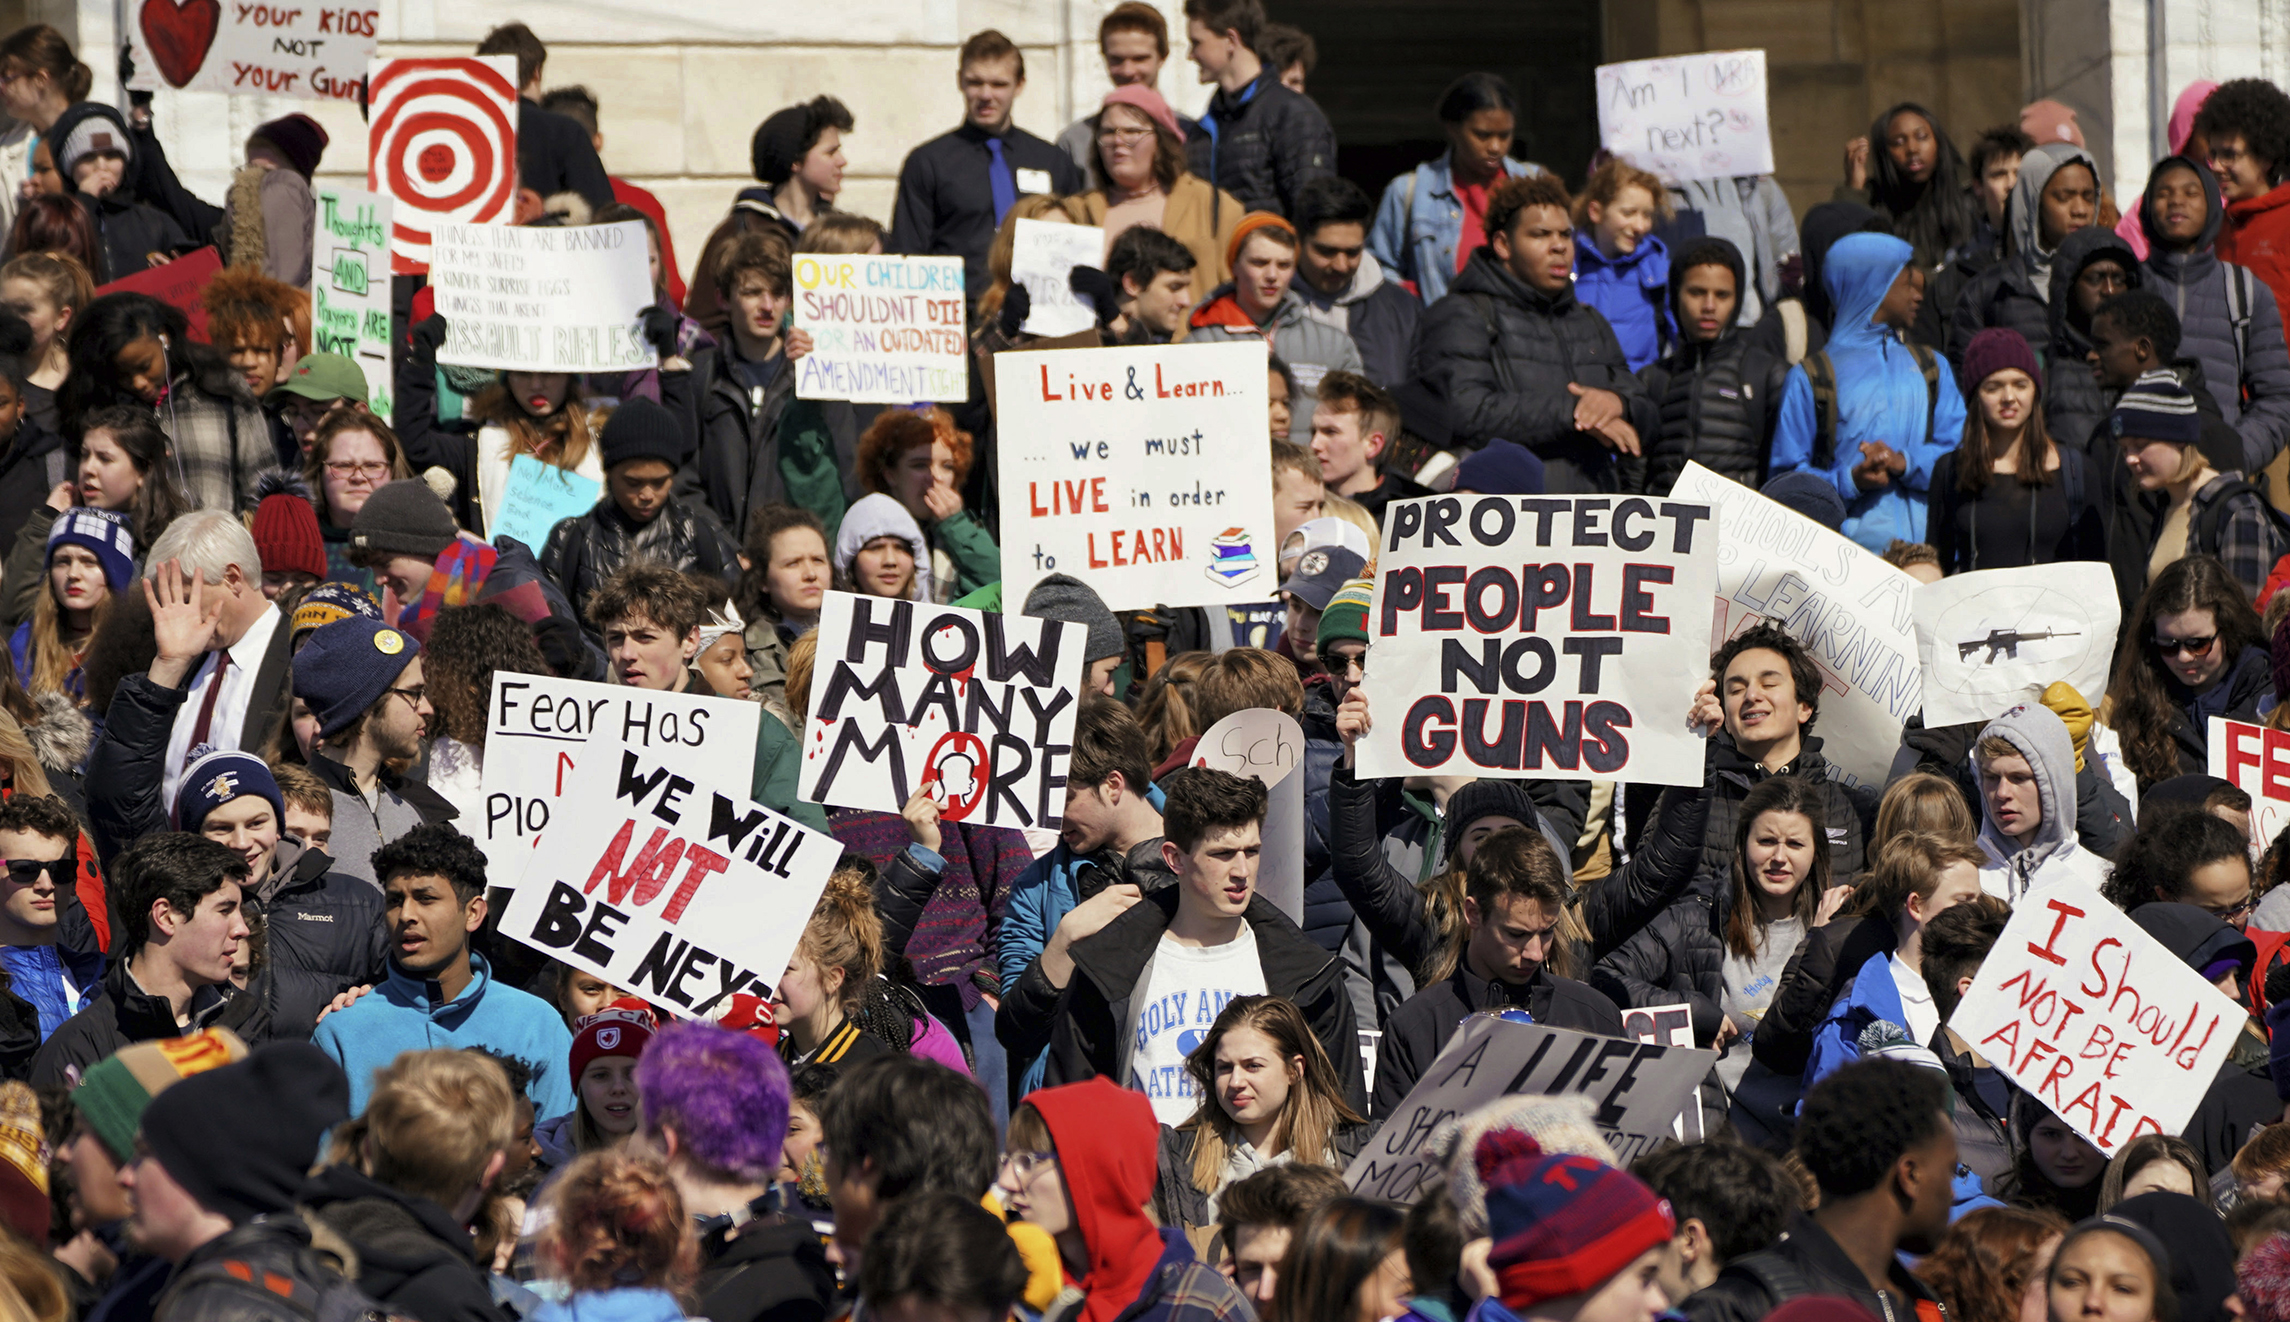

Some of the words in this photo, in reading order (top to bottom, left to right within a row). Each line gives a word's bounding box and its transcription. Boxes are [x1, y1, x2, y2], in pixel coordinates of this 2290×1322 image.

[273, 37, 324, 58] NOT
[1611, 76, 1656, 110] Am
[1681, 67, 1688, 97] I
[1646, 108, 1725, 152] next?
[320, 196, 384, 249] Thoughts
[434, 224, 485, 247] THINGS
[491, 226, 522, 249] THAT
[531, 229, 554, 251] ARE
[564, 226, 624, 251] BANNED
[333, 256, 366, 290] AND
[434, 246, 458, 264] FOR
[486, 251, 524, 271] SAFETY
[794, 259, 857, 290] OUR
[866, 261, 966, 291] CHILDREN
[439, 294, 482, 316] THINGS
[487, 299, 508, 317] THAT
[487, 276, 529, 296] SURPRISE
[538, 277, 571, 296] EGGS
[362, 309, 387, 340] ARE
[802, 291, 919, 325] SHOULDNT
[926, 299, 962, 325] DIE
[442, 317, 542, 362] ASSAULT
[854, 329, 876, 353] AN
[880, 328, 964, 356] OUTDATED
[799, 356, 926, 396] AMENDMENT
[1040, 363, 1114, 402] Live
[1124, 365, 1145, 401] &
[1069, 441, 1110, 460] we
[1144, 428, 1204, 456] must
[516, 466, 533, 481] No
[1029, 476, 1110, 518] LIVE
[1131, 489, 1151, 508] in
[1169, 480, 1226, 507] order
[1388, 496, 1711, 555] PROTECT
[1031, 543, 1056, 571] to
[1380, 562, 1675, 637] PEOPLE
[846, 597, 1064, 689] HOW
[1440, 636, 1623, 695] NOT
[499, 682, 610, 735] Fear
[815, 659, 1074, 749] MANY
[1401, 694, 1633, 774] GUNS
[615, 748, 696, 826] WE
[811, 716, 1072, 831] MORE
[582, 817, 732, 925] NOT
[296, 911, 334, 923] Marmot
[529, 879, 632, 968] BE
[1744, 974, 1774, 998] Holy
[2026, 898, 2086, 967] I
[2080, 937, 2220, 1071] Should
[1136, 988, 1188, 1051] HOLY
[1997, 969, 2085, 1042] NOT
[2078, 1024, 2138, 1080] BE
[1438, 1035, 1492, 1088] A
